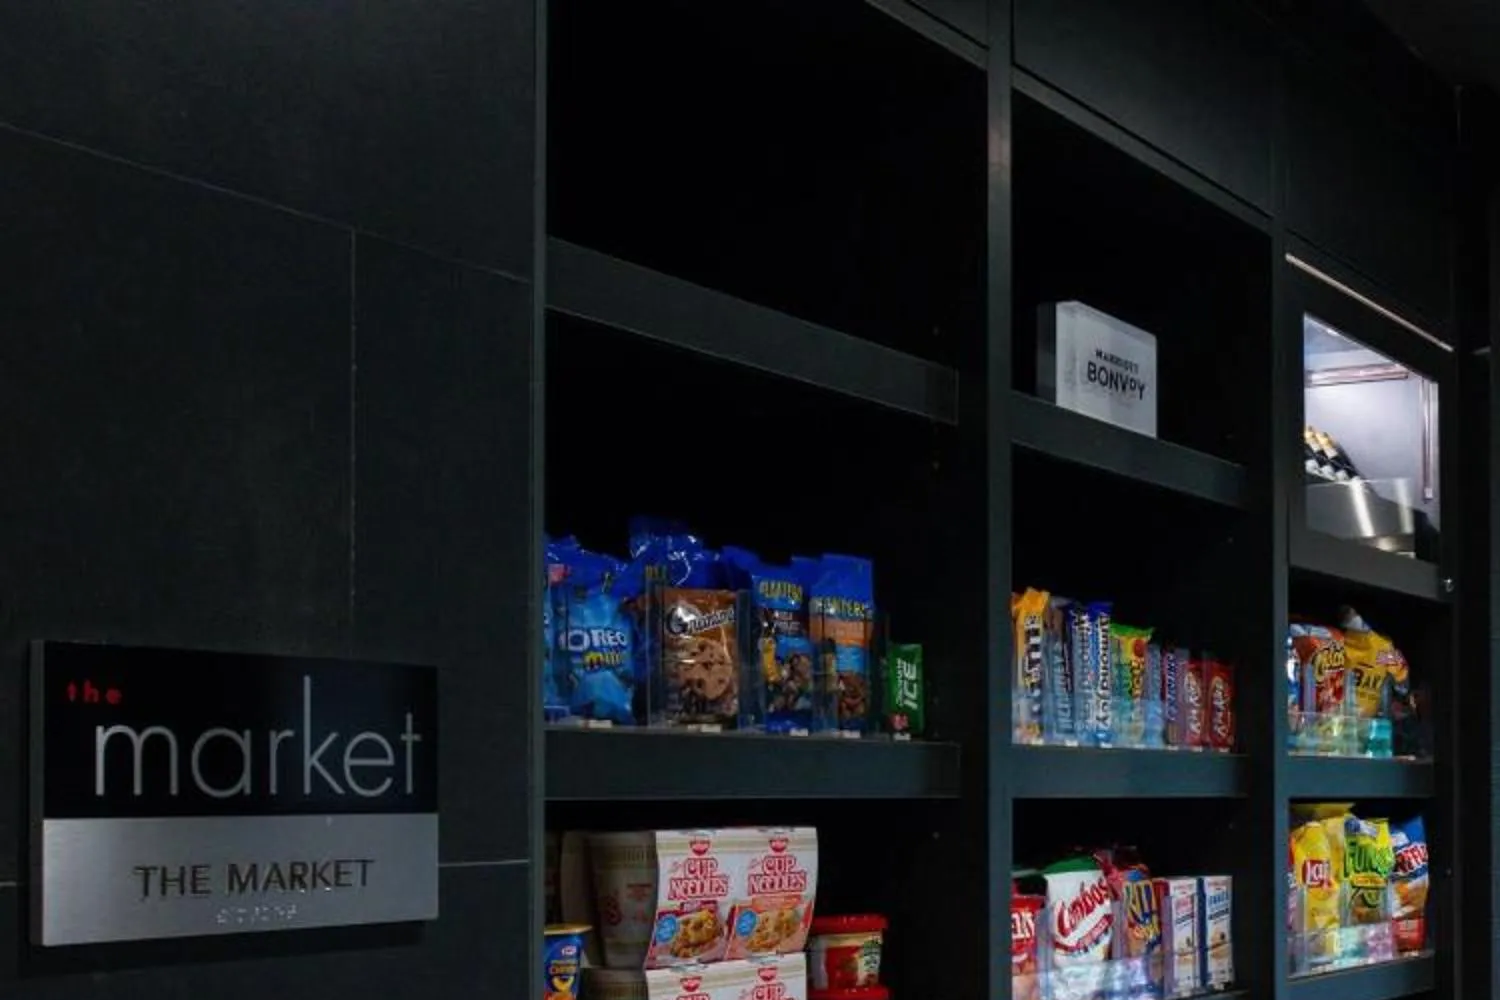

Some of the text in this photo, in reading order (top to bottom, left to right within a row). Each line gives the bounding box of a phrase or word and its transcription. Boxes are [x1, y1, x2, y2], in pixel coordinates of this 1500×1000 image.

[1087, 360, 1145, 401] BONVOY
[67, 681, 122, 704] the
[902, 657, 919, 710] ICE
[95, 674, 422, 797] market
[134, 858, 376, 899] THE MARKET
[669, 876, 729, 900] NOODLES
[748, 871, 807, 895] NOODLES
